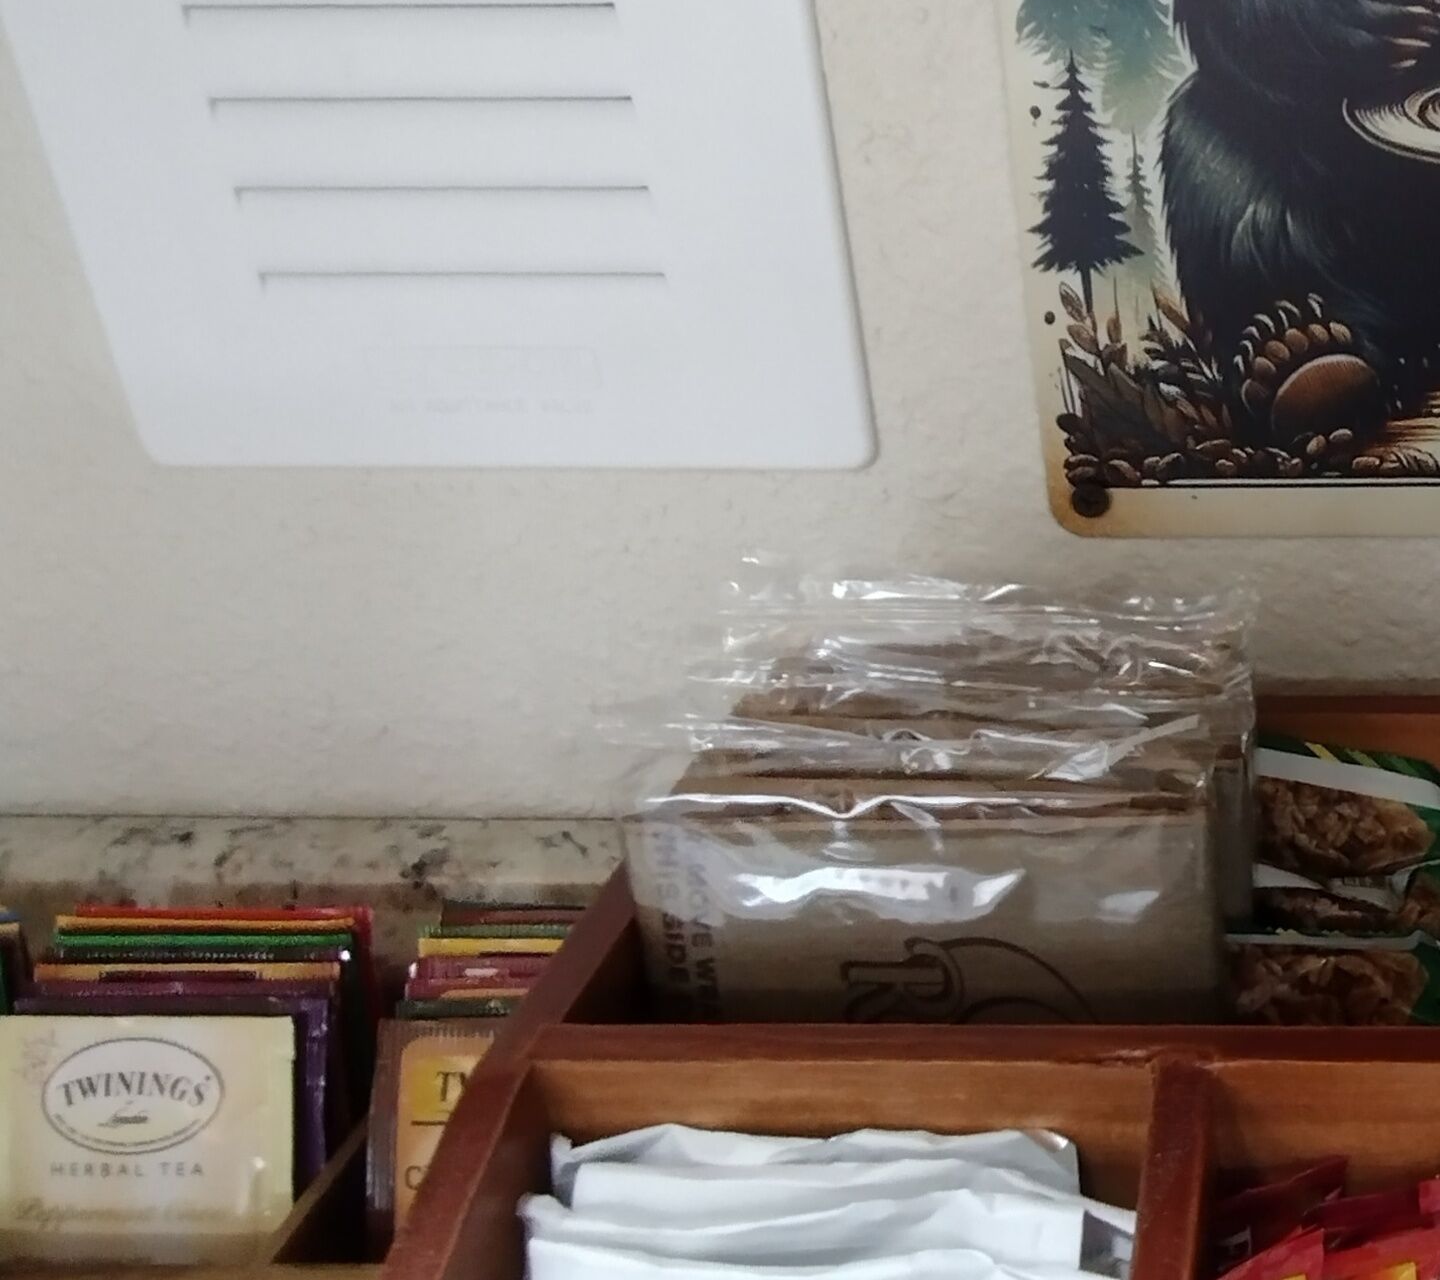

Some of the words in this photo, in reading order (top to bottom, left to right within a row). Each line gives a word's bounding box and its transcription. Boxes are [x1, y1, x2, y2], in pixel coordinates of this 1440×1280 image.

[57, 1071, 208, 1107] TWININGS
[51, 1162, 144, 1179] HERBAL
[160, 1162, 204, 1177] TEA
